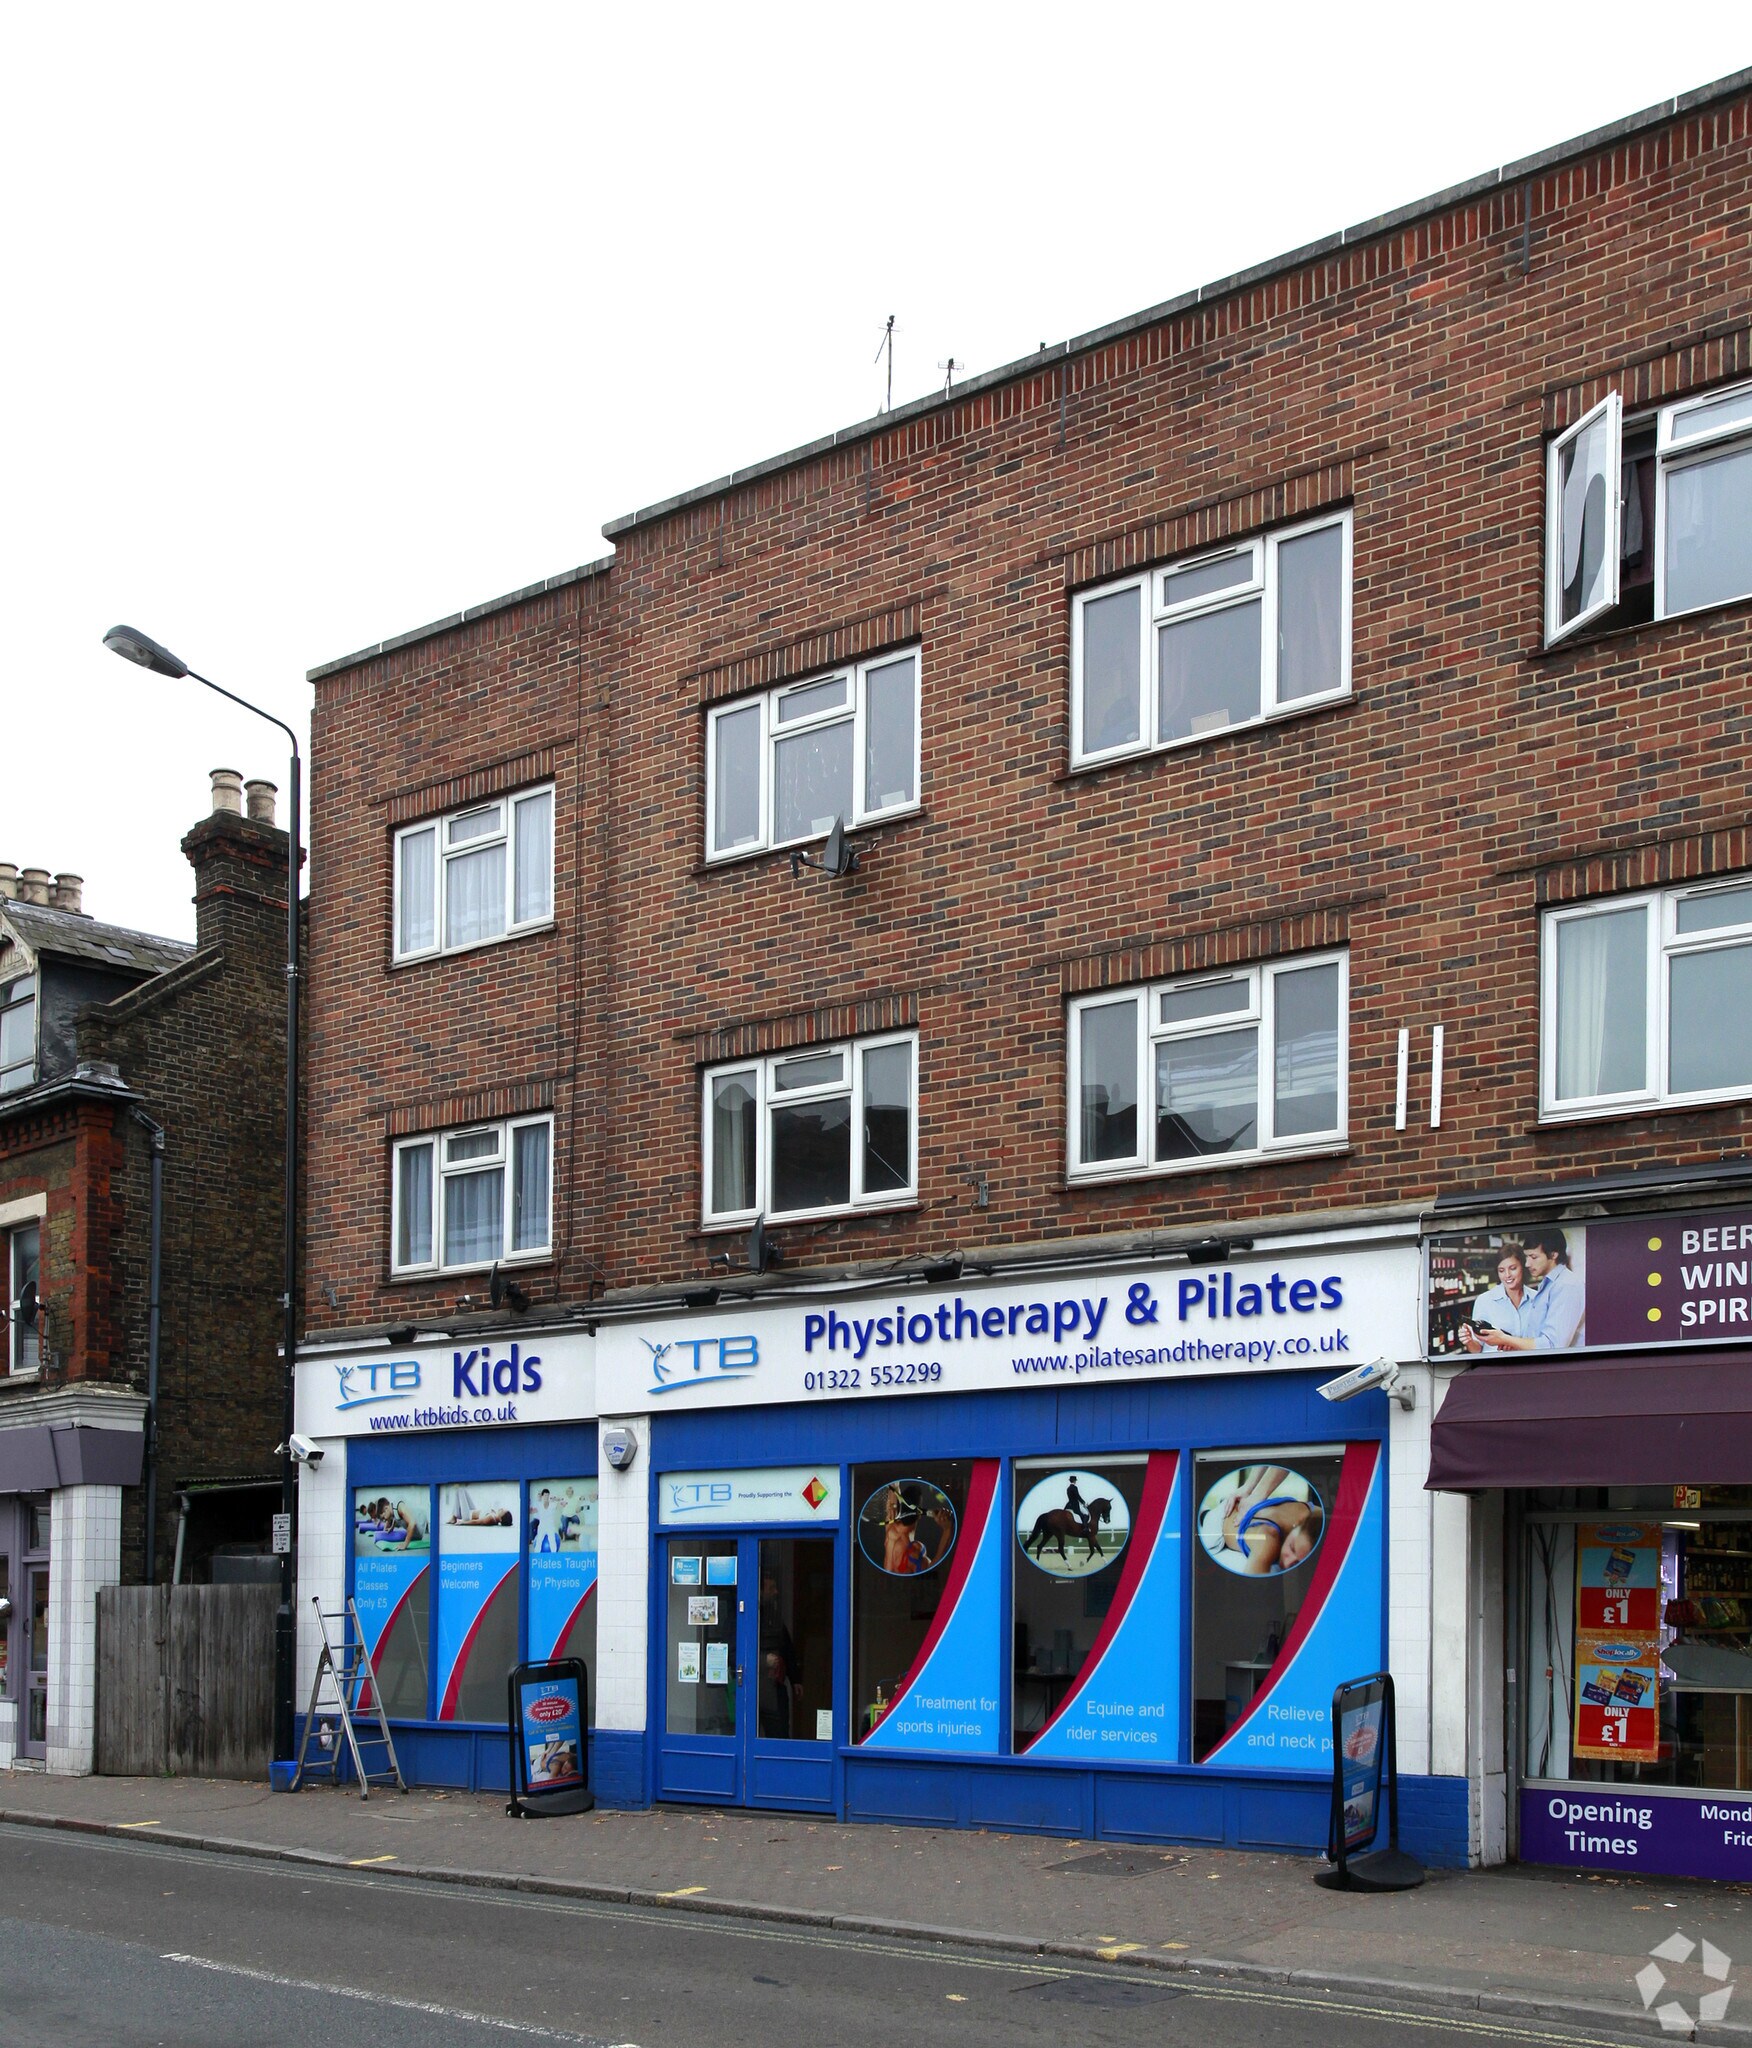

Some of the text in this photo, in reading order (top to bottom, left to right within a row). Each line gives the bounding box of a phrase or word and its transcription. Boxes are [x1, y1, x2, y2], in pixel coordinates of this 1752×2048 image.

[1682, 1224, 1752, 1255] BEER
[1680, 1261, 1752, 1290] WIN
[804, 1271, 1343, 1359] Physiotherapy & Pilates
[1681, 1297, 1752, 1326] SPIR
[1011, 1328, 1349, 1374] www.pilatesandtherapy.co.uk
[453, 1343, 542, 1398] Kids
[804, 1361, 943, 1391] 01322 552299
[369, 1401, 517, 1430] www.ktbkids.co.uk
[738, 1491, 756, 1499] Proudly
[757, 1491, 783, 1499] Supporting
[357, 1562, 398, 1573] All Pilates
[441, 1560, 483, 1574] Beginners
[531, 1557, 596, 1572] Pilates Taught
[357, 1581, 389, 1591] Classes
[441, 1579, 480, 1590] Welcome
[531, 1576, 581, 1591] by Physios
[1605, 1588, 1631, 1599] ONLY
[357, 1598, 387, 1611] Only £5
[1603, 1599, 1629, 1624] £1
[914, 1694, 997, 1712] Treatment for
[1087, 1700, 1164, 1718] Equine and
[1604, 1706, 1630, 1718] ONLY
[1268, 1704, 1324, 1722] Relieve
[896, 1720, 982, 1737] sports injuries
[1066, 1726, 1158, 1743] rider services
[1601, 1718, 1628, 1743] £1
[1247, 1732, 1275, 1747] and
[1280, 1734, 1316, 1749] neck
[1548, 1798, 1653, 1830] Opening
[1701, 1804, 1752, 1822] Mond
[1564, 1830, 1638, 1855] Times
